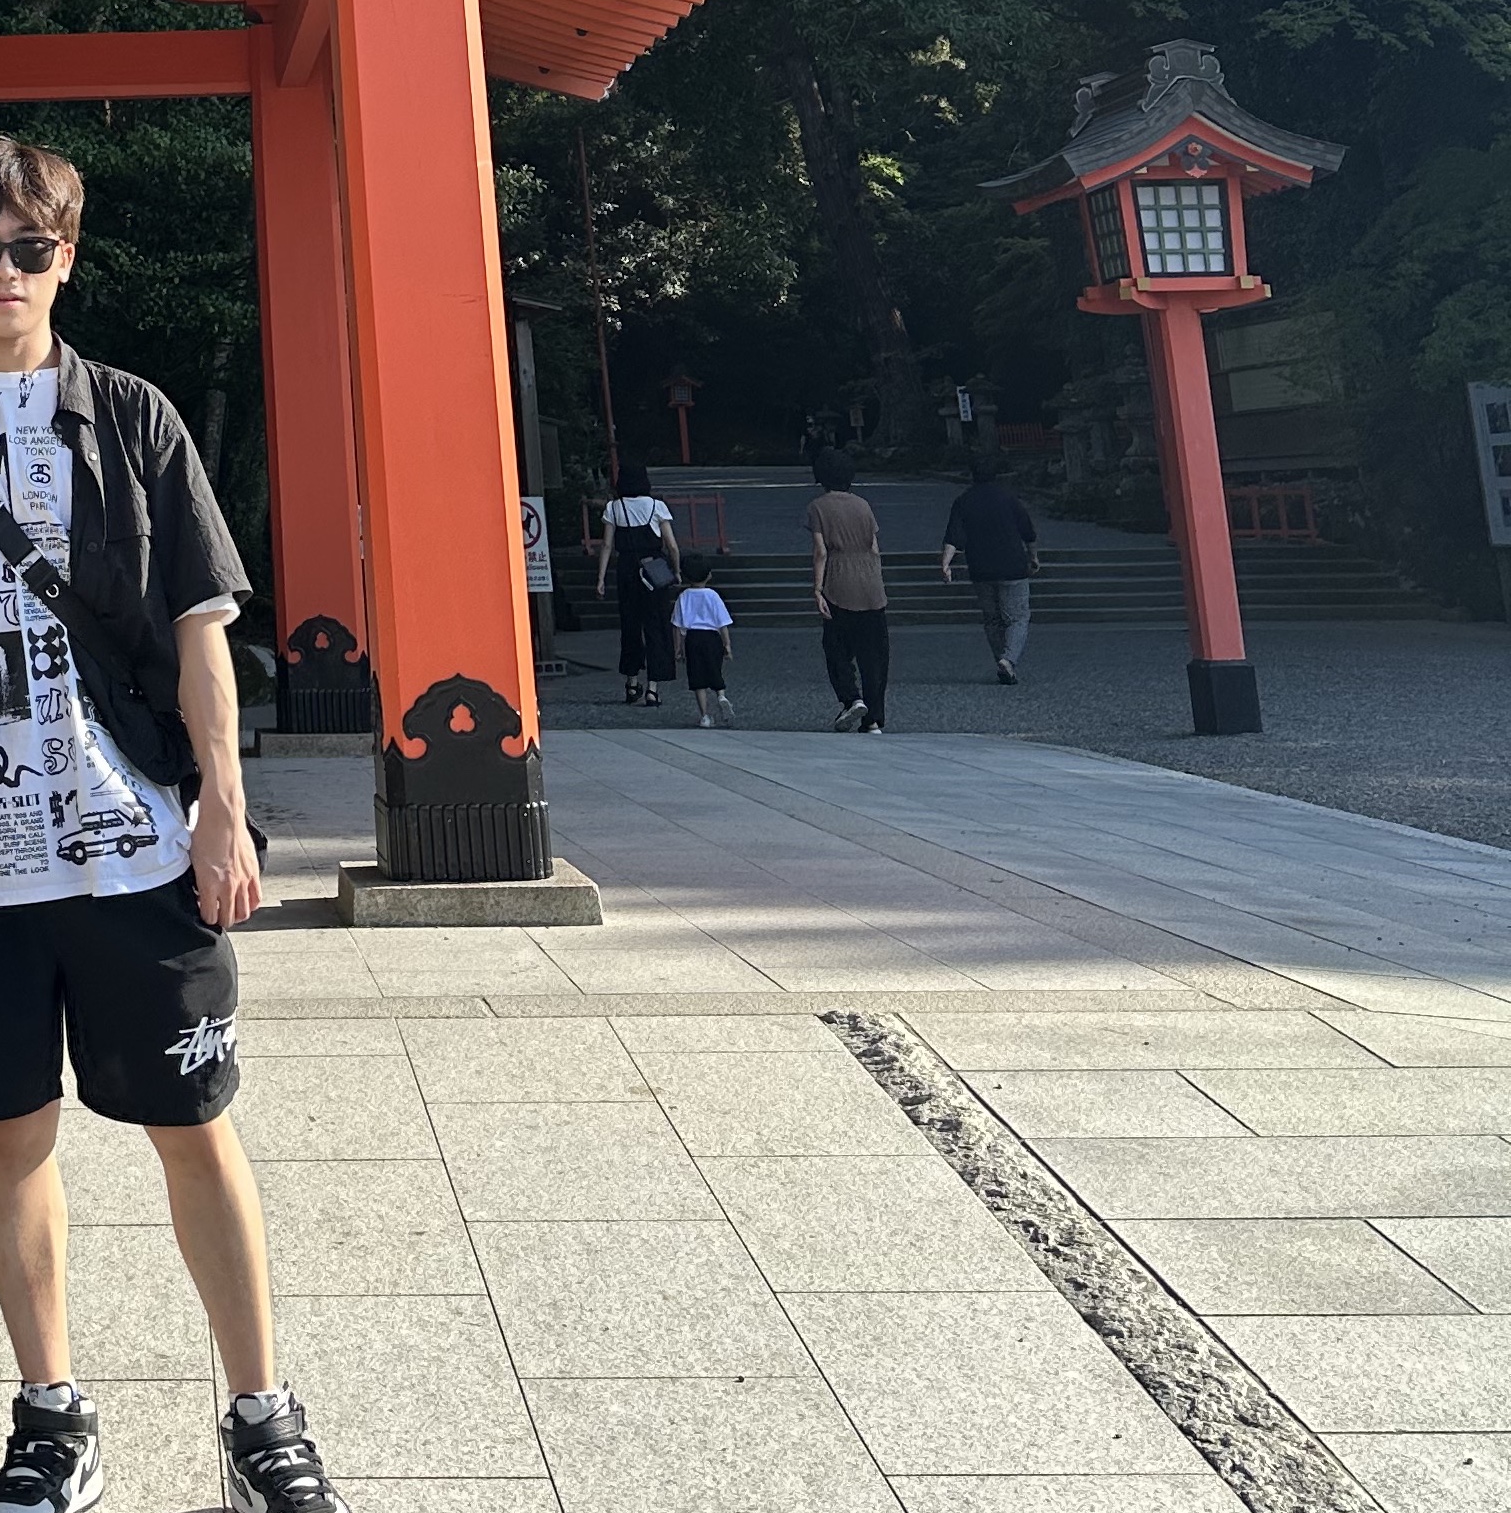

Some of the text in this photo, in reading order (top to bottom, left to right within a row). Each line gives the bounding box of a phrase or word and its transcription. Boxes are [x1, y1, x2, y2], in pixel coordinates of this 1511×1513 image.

[15, 426, 55, 435] NEW YO
[8, 435, 27, 445] LOS
[25, 447, 57, 456] TOKYO
[22, 490, 58, 503] LONDON
